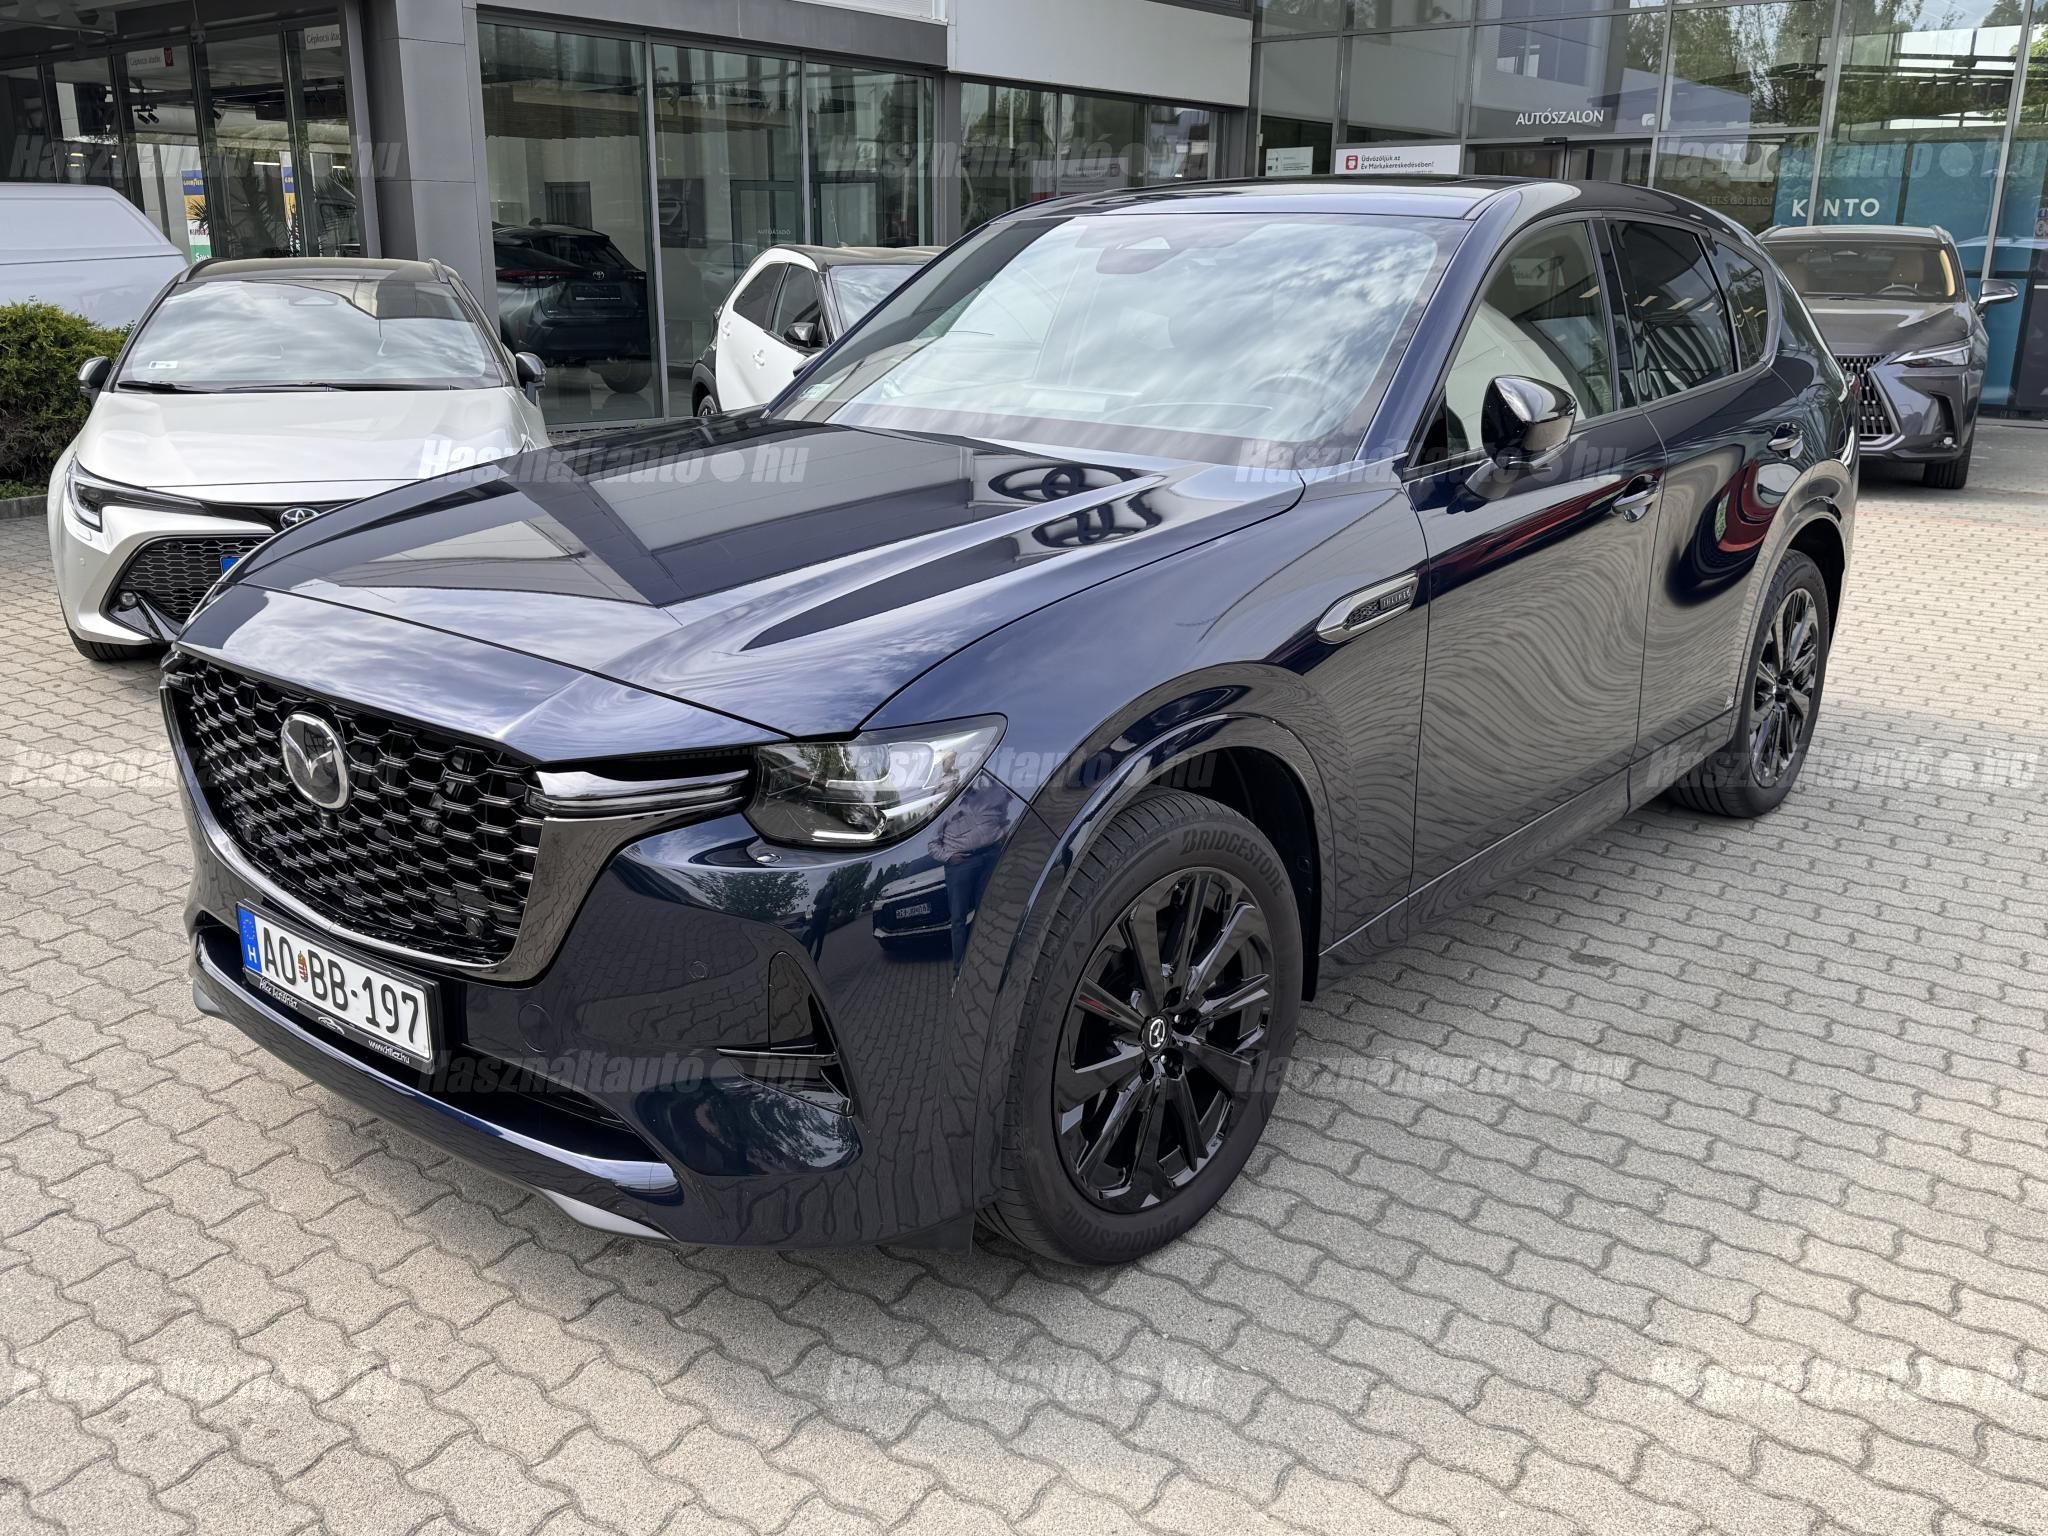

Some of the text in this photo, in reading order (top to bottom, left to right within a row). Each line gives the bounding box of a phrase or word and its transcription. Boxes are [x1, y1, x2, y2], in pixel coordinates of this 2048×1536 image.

[1515, 108, 1604, 126] AUTÓSZALON
[1361, 154, 1392, 163] Üdvözöljük
[1791, 198, 1880, 218] KNTO
[1181, 829, 1287, 897] BRIDGESTONE
[247, 944, 257, 964] H
[263, 926, 419, 1044] AO BB-197
